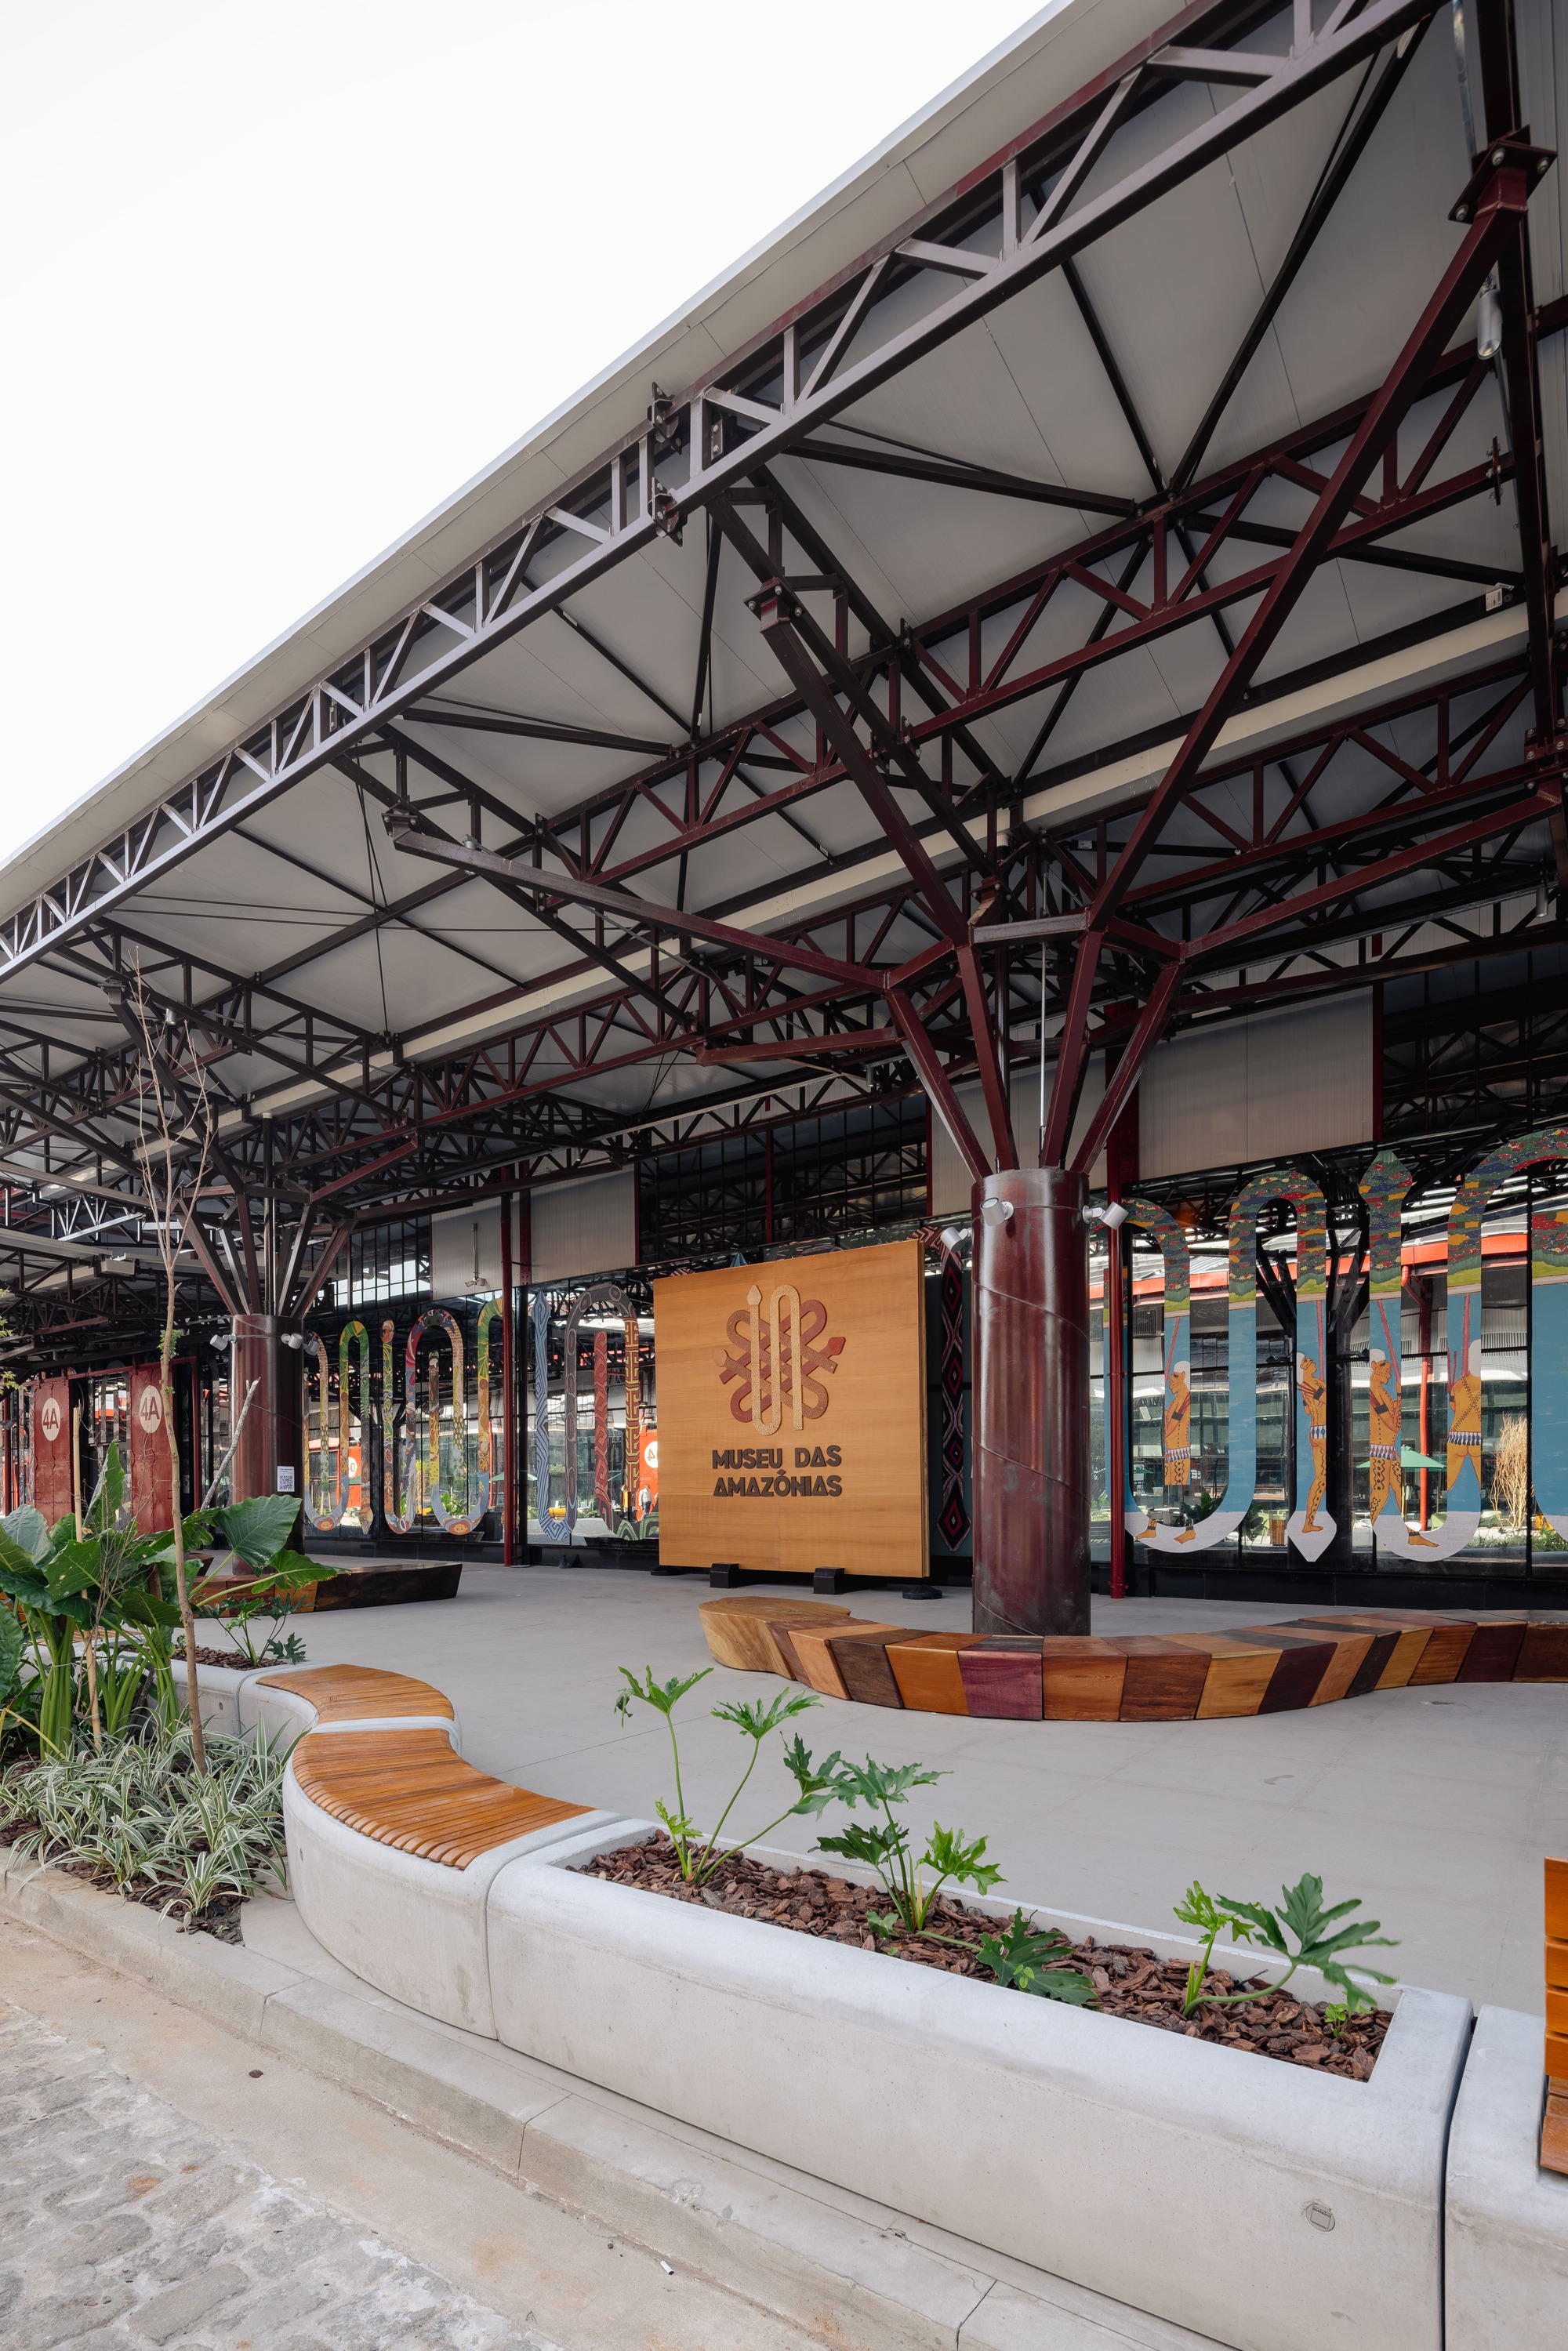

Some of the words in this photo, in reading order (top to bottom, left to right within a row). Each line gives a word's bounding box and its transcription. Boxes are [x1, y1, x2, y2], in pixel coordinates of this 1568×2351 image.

[42, 1408, 59, 1429] 4A
[140, 1396, 160, 1420] 4A
[712, 1448, 782, 1469] MUSEU
[795, 1445, 841, 1468] DAS
[713, 1469, 843, 1497] AMAZÔNIAS
